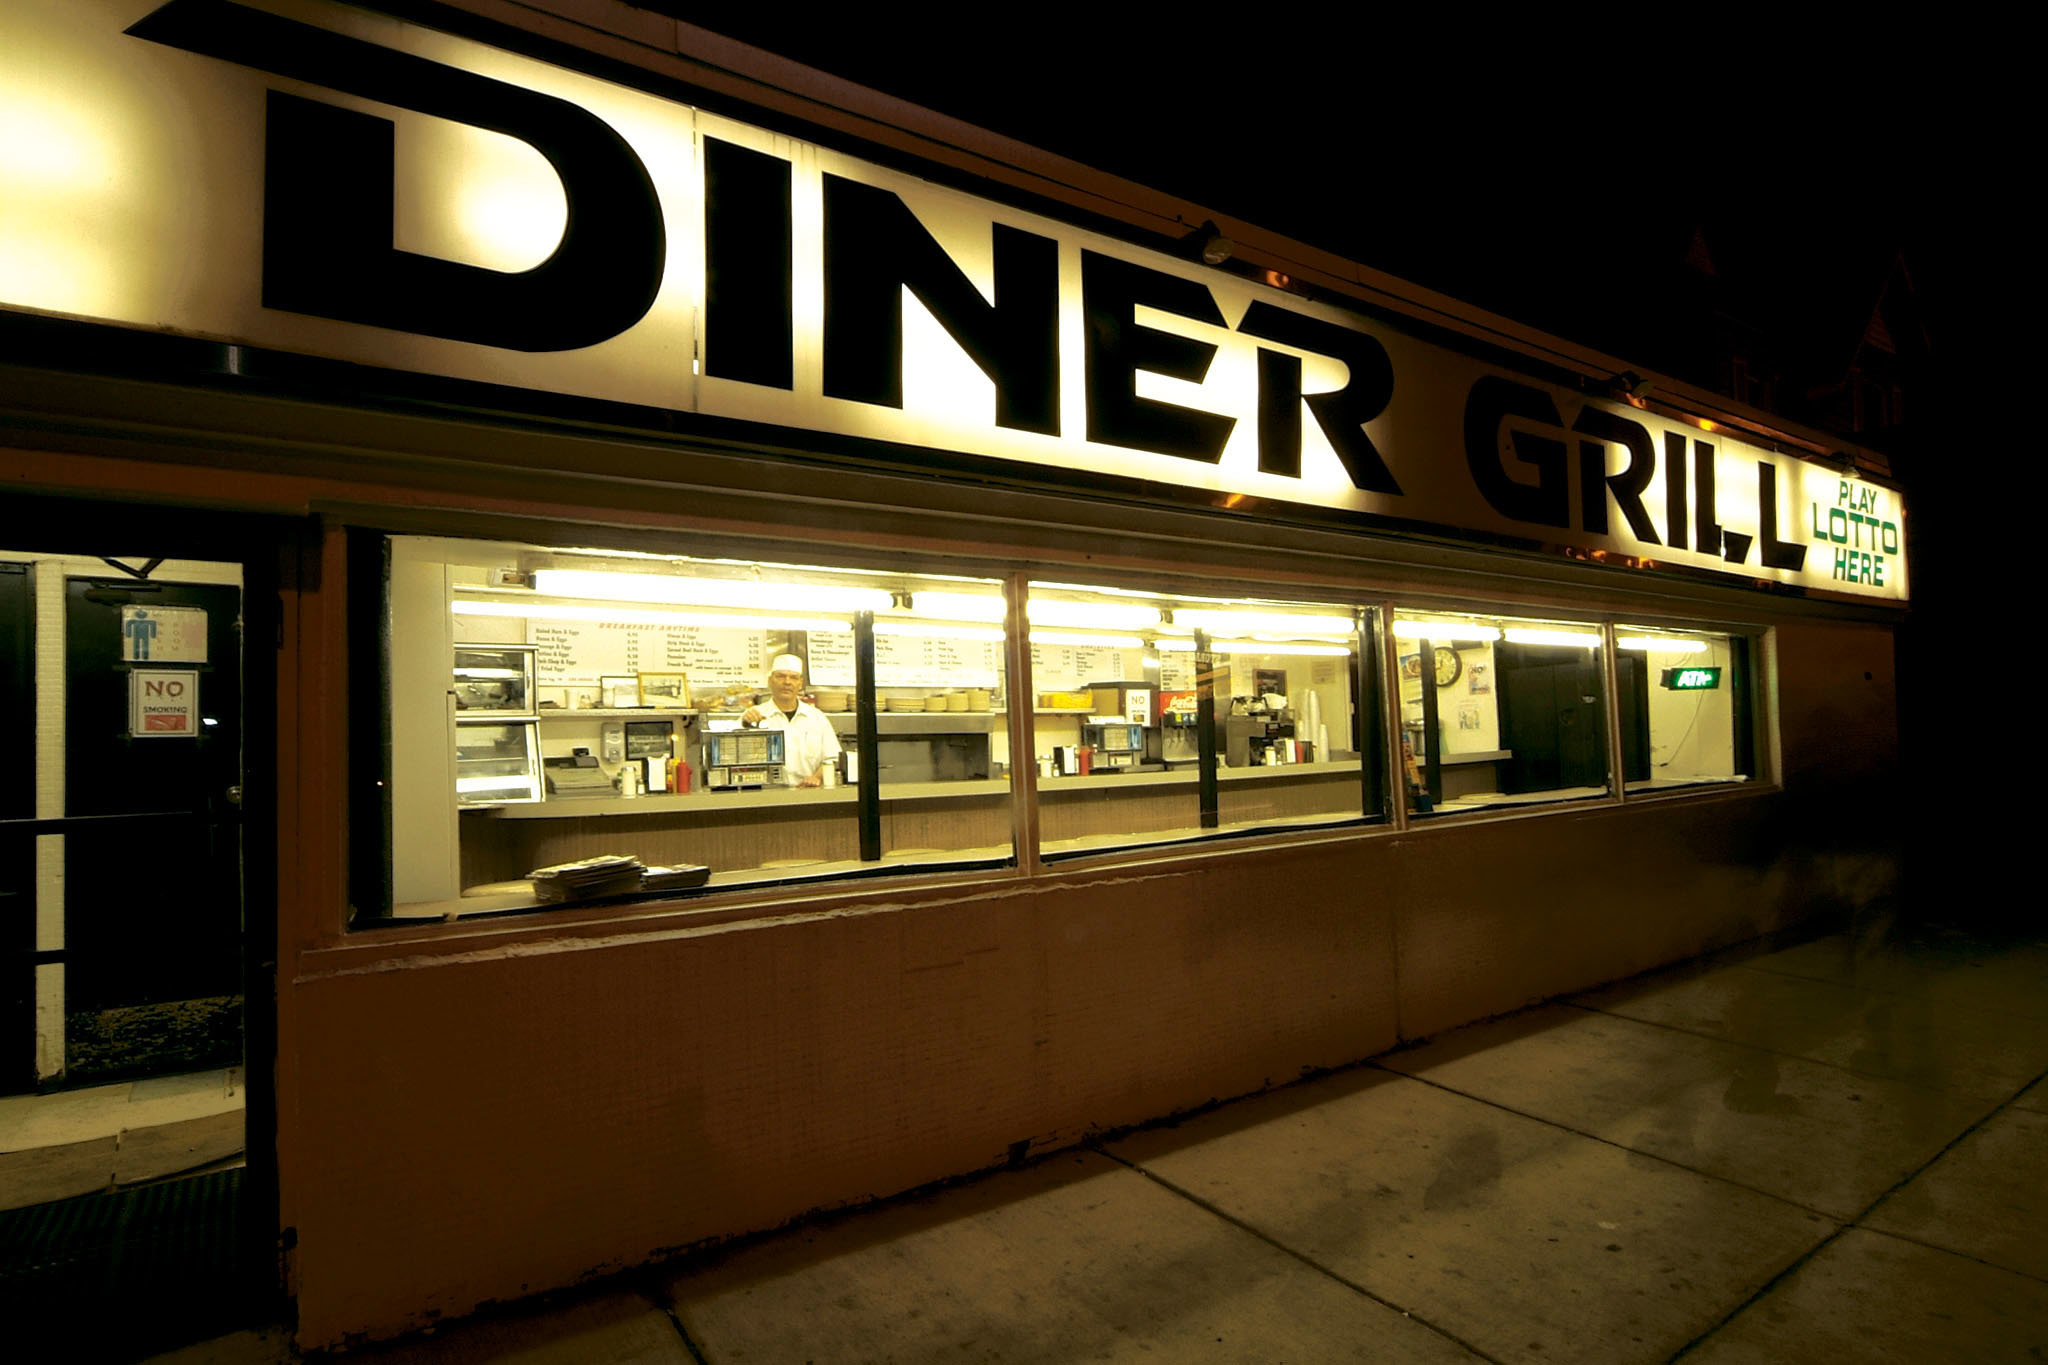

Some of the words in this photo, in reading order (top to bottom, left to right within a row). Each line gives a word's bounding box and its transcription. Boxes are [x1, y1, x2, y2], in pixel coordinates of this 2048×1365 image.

[123, 0, 1404, 496] DINER
[1464, 375, 1807, 572] GRILL
[1838, 480, 1877, 515] PLAY
[1813, 502, 1898, 556] LOTTO
[1833, 547, 1884, 587] HERE
[145, 681, 184, 697] NO
[1131, 695, 1145, 704] NO
[143, 706, 188, 714] SMOKING
